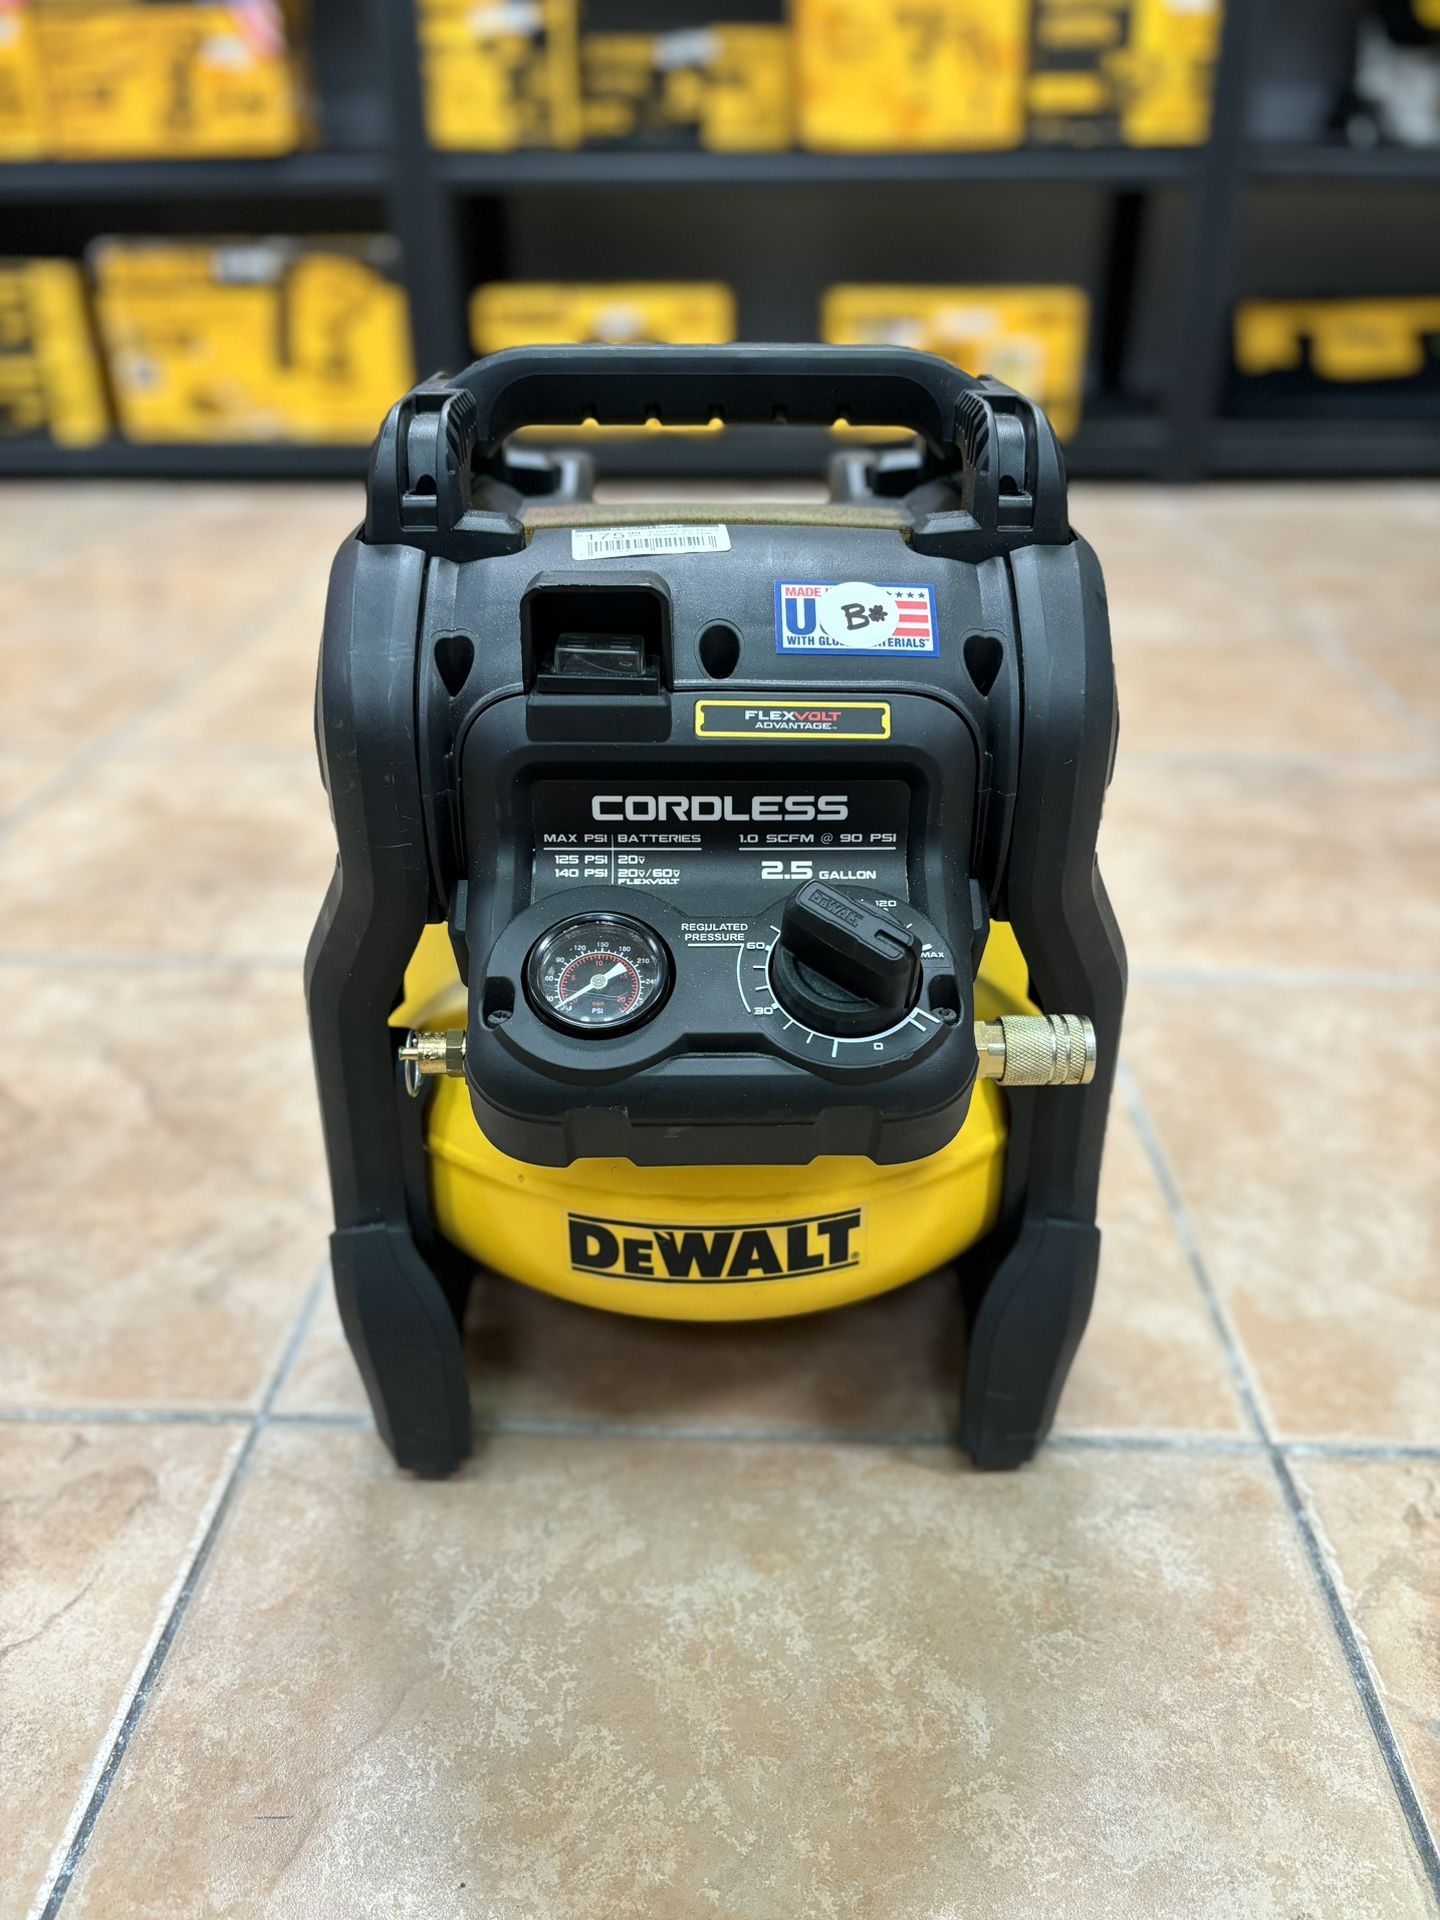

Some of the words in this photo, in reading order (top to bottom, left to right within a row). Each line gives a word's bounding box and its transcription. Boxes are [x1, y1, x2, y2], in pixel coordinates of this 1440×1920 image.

[785, 587, 822, 597] MADE
[786, 635, 815, 646] WITH
[744, 710, 842, 722] FLEXVOLT
[754, 722, 832, 730] ADVANTAGE
[591, 795, 849, 821] CORDLESS
[543, 834, 578, 843] MAX
[584, 834, 608, 843] PSI
[617, 834, 702, 843] BATTERIES
[738, 834, 759, 843] 1.0
[766, 834, 815, 843] SCFM
[820, 833, 834, 845] @
[840, 834, 863, 843] 90
[870, 833, 897, 843] PSI
[554, 855, 579, 865] 125
[584, 855, 608, 864] PSI
[554, 868, 579, 878] 140
[584, 868, 608, 878] PSI
[761, 860, 814, 880] 2.5
[818, 870, 877, 880] GALLON
[617, 878, 680, 886] FLEXVOLT
[875, 900, 897, 908] 120
[681, 923, 748, 932] REGULATED
[684, 933, 745, 942] PRESSURE
[746, 942, 765, 950] 60
[753, 1006, 774, 1015] 30
[873, 1042, 884, 1051] 0
